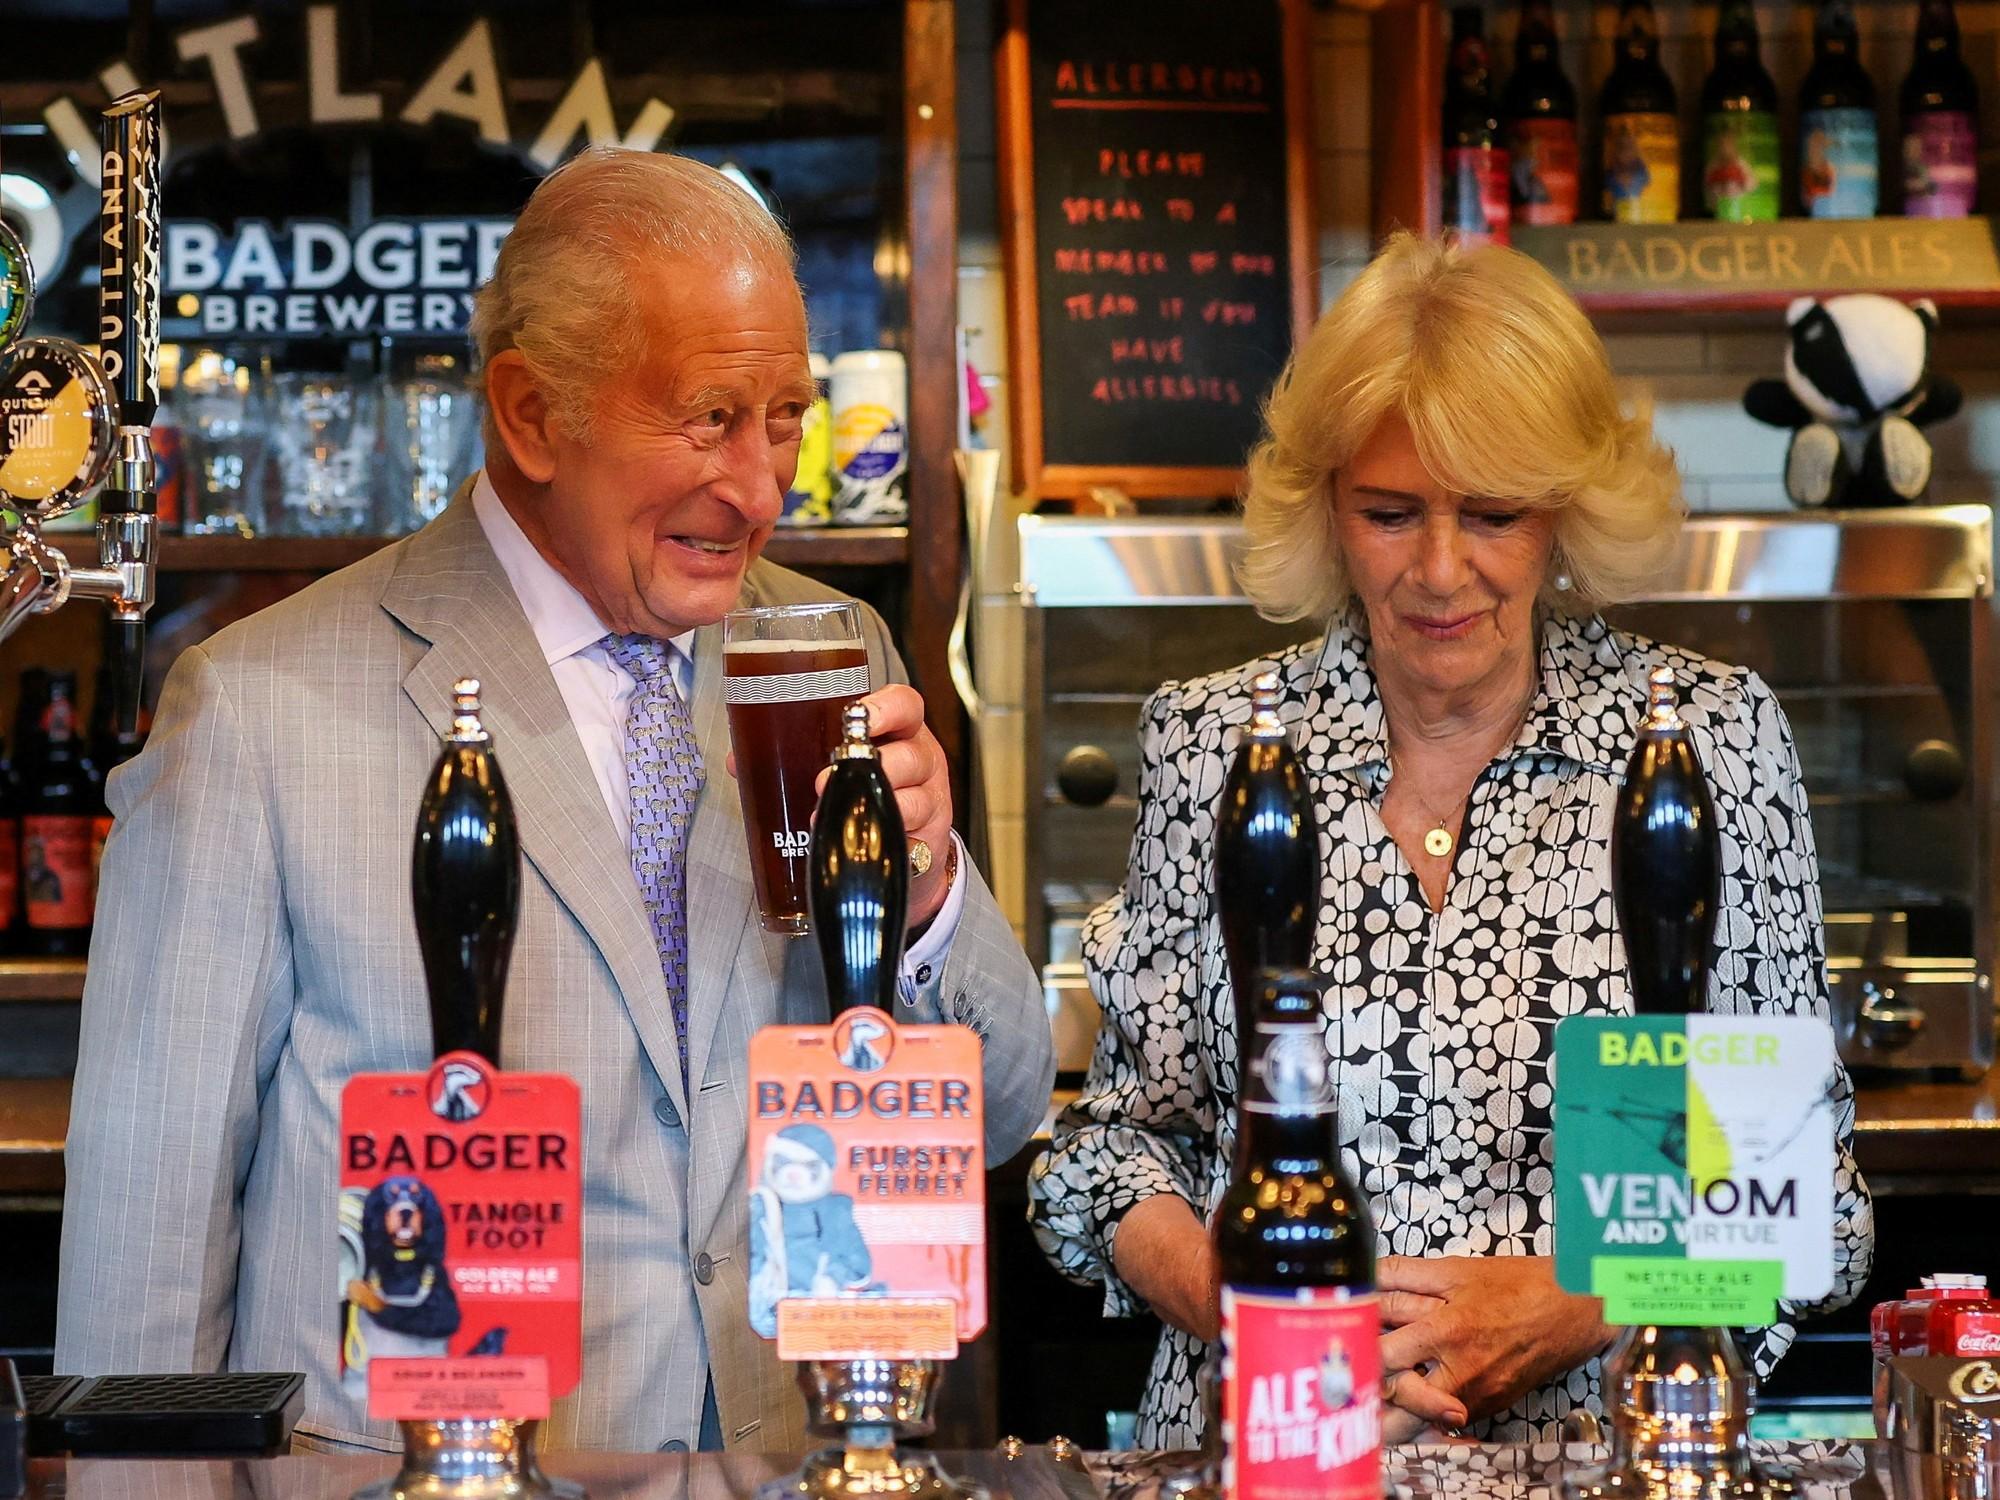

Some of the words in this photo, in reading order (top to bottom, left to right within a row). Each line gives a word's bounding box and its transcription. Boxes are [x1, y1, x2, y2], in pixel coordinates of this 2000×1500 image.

[101, 150, 124, 379] OUTLAND
[1567, 236, 1803, 284] BADGER
[1818, 235, 1954, 281] ALES
[203, 294, 476, 332] BREWER
[8, 414, 55, 449] STOUT
[1600, 1032, 1781, 1066] BADGER
[757, 1079, 971, 1119] BADGER
[347, 1134, 567, 1171] BADGER
[849, 1145, 975, 1172] FURSTY
[859, 1174, 968, 1197] FERRET
[1580, 1173, 1798, 1219] VENOM
[449, 1203, 563, 1225] TANGLE
[466, 1229, 545, 1249] FOOT
[1602, 1221, 1667, 1245] AND
[1672, 1221, 1779, 1245] VIRTUE
[1247, 1366, 1319, 1426] ALE
